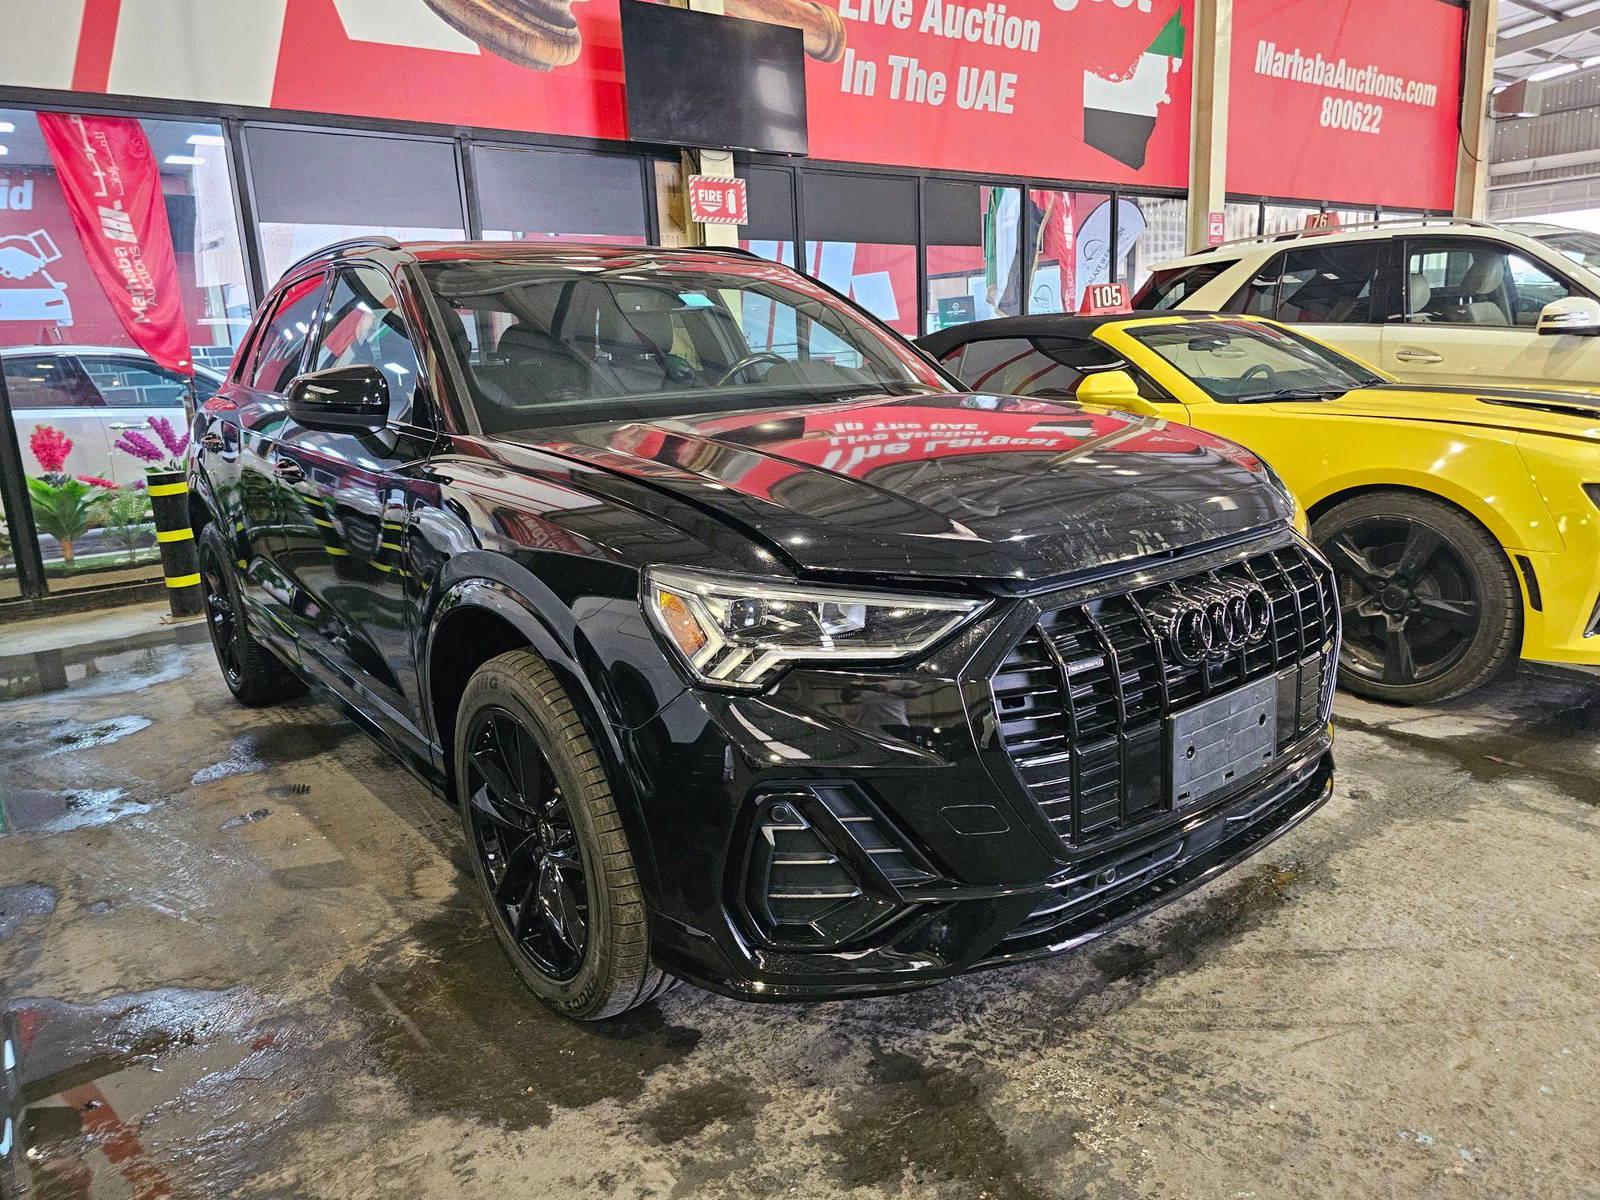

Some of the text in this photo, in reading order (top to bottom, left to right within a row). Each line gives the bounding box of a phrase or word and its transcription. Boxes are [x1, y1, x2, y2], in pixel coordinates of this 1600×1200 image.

[919, 0, 1041, 52] Auction
[841, 48, 1018, 114] In The UAE
[1255, 40, 1437, 107] MarhabaAuctions.com
[1320, 96, 1383, 134] 800622
[698, 189, 722, 202] FIRE
[1312, 215, 1328, 228] 76
[114, 246, 151, 323] Marhaba
[128, 245, 158, 306] Auctions
[1094, 285, 1122, 308] 105
